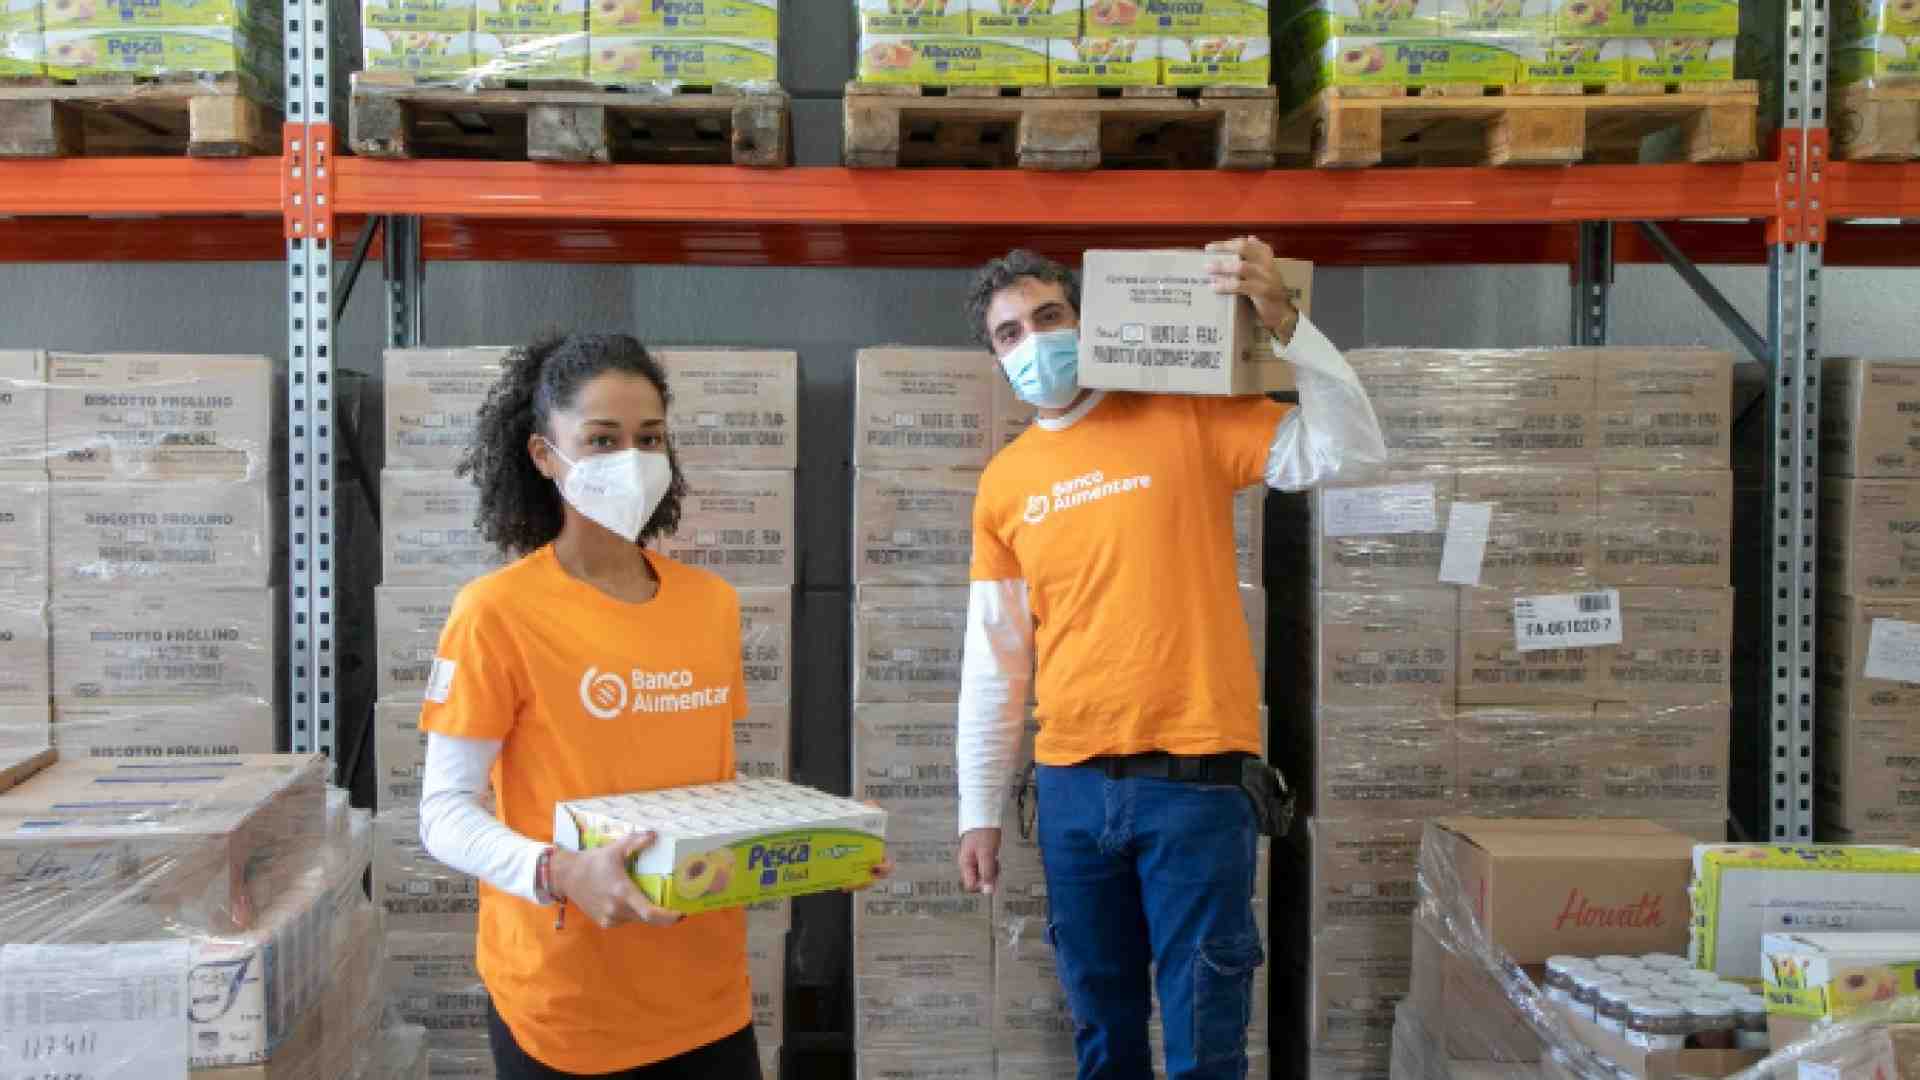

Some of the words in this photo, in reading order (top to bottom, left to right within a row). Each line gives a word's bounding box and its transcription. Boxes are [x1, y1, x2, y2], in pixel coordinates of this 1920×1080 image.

[1052, 470, 1104, 496] Banco
[1054, 475, 1152, 512] Alimentare
[631, 667, 693, 690] Banco
[747, 843, 810, 872] Pesca
